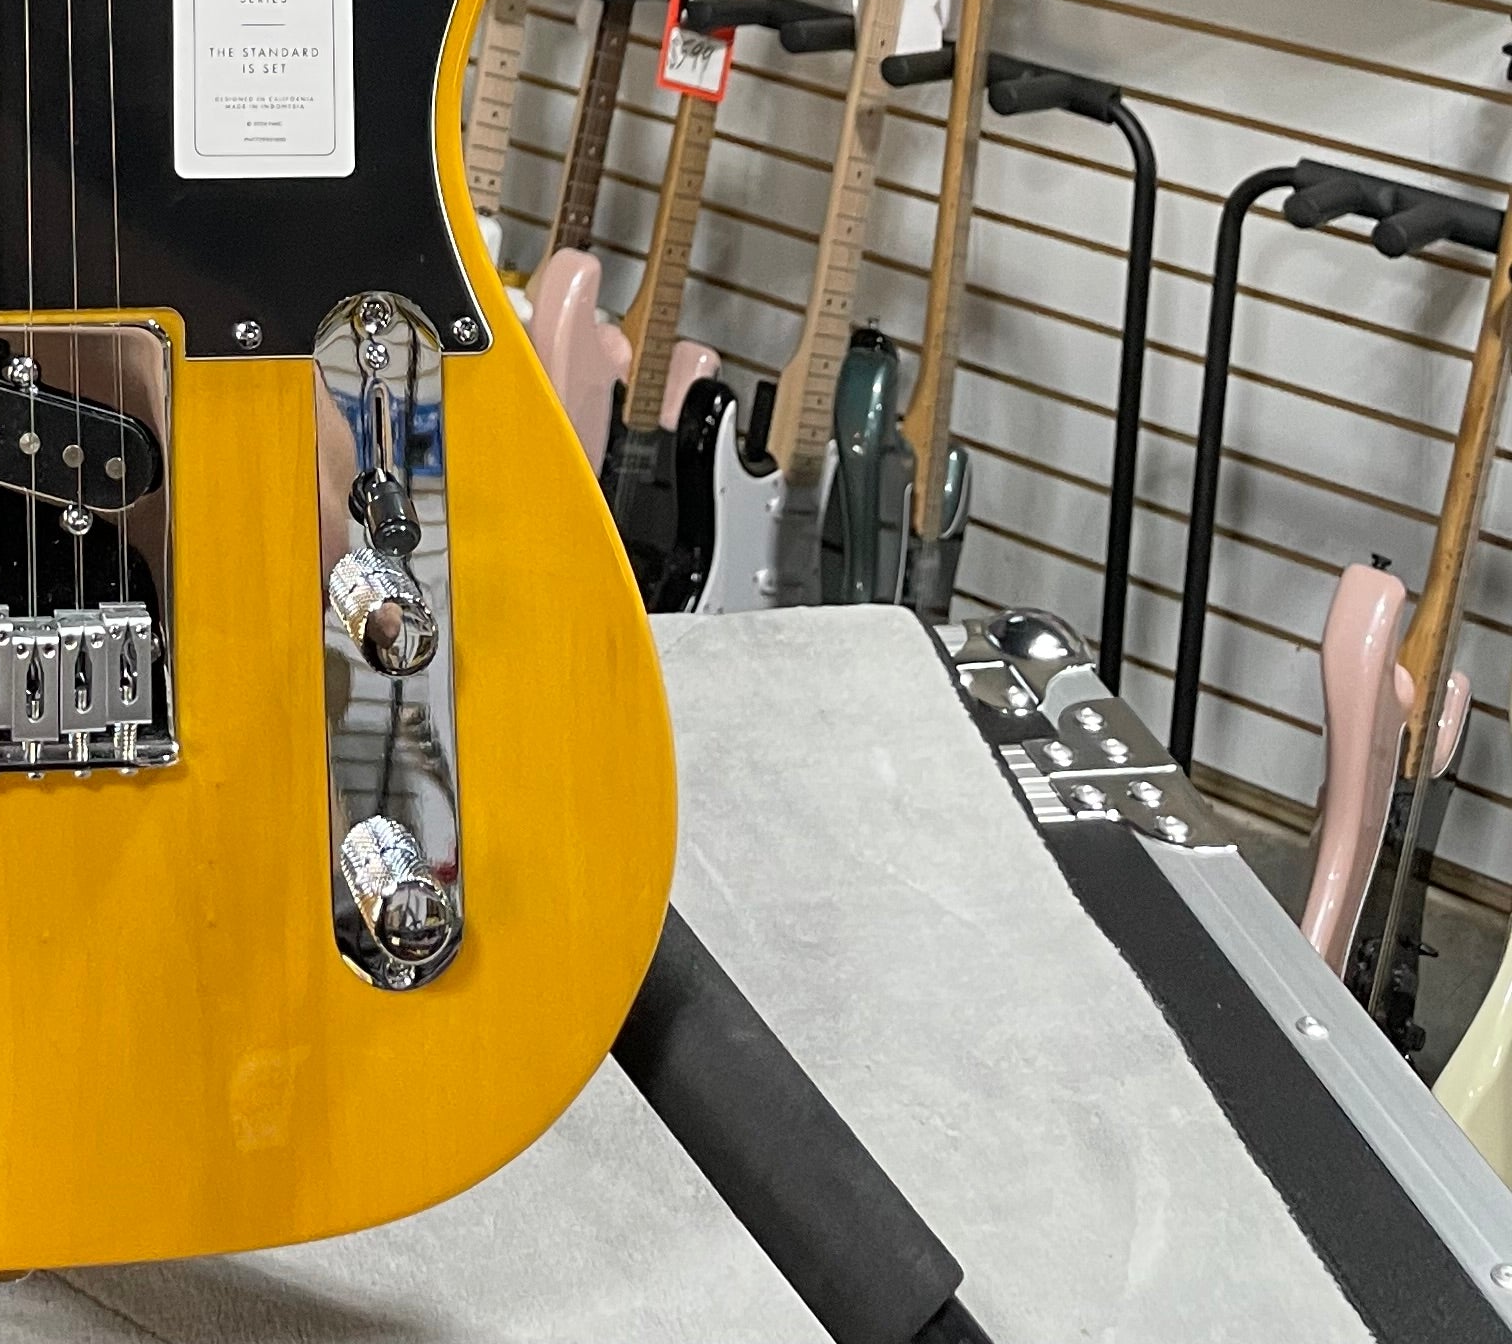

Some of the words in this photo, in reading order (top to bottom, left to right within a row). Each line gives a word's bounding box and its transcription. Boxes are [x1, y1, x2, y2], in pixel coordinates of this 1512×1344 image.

[209, 46, 235, 58] THE
[242, 46, 320, 58] STANDARD
[242, 63, 256, 75] IS
[263, 63, 287, 75] SET
